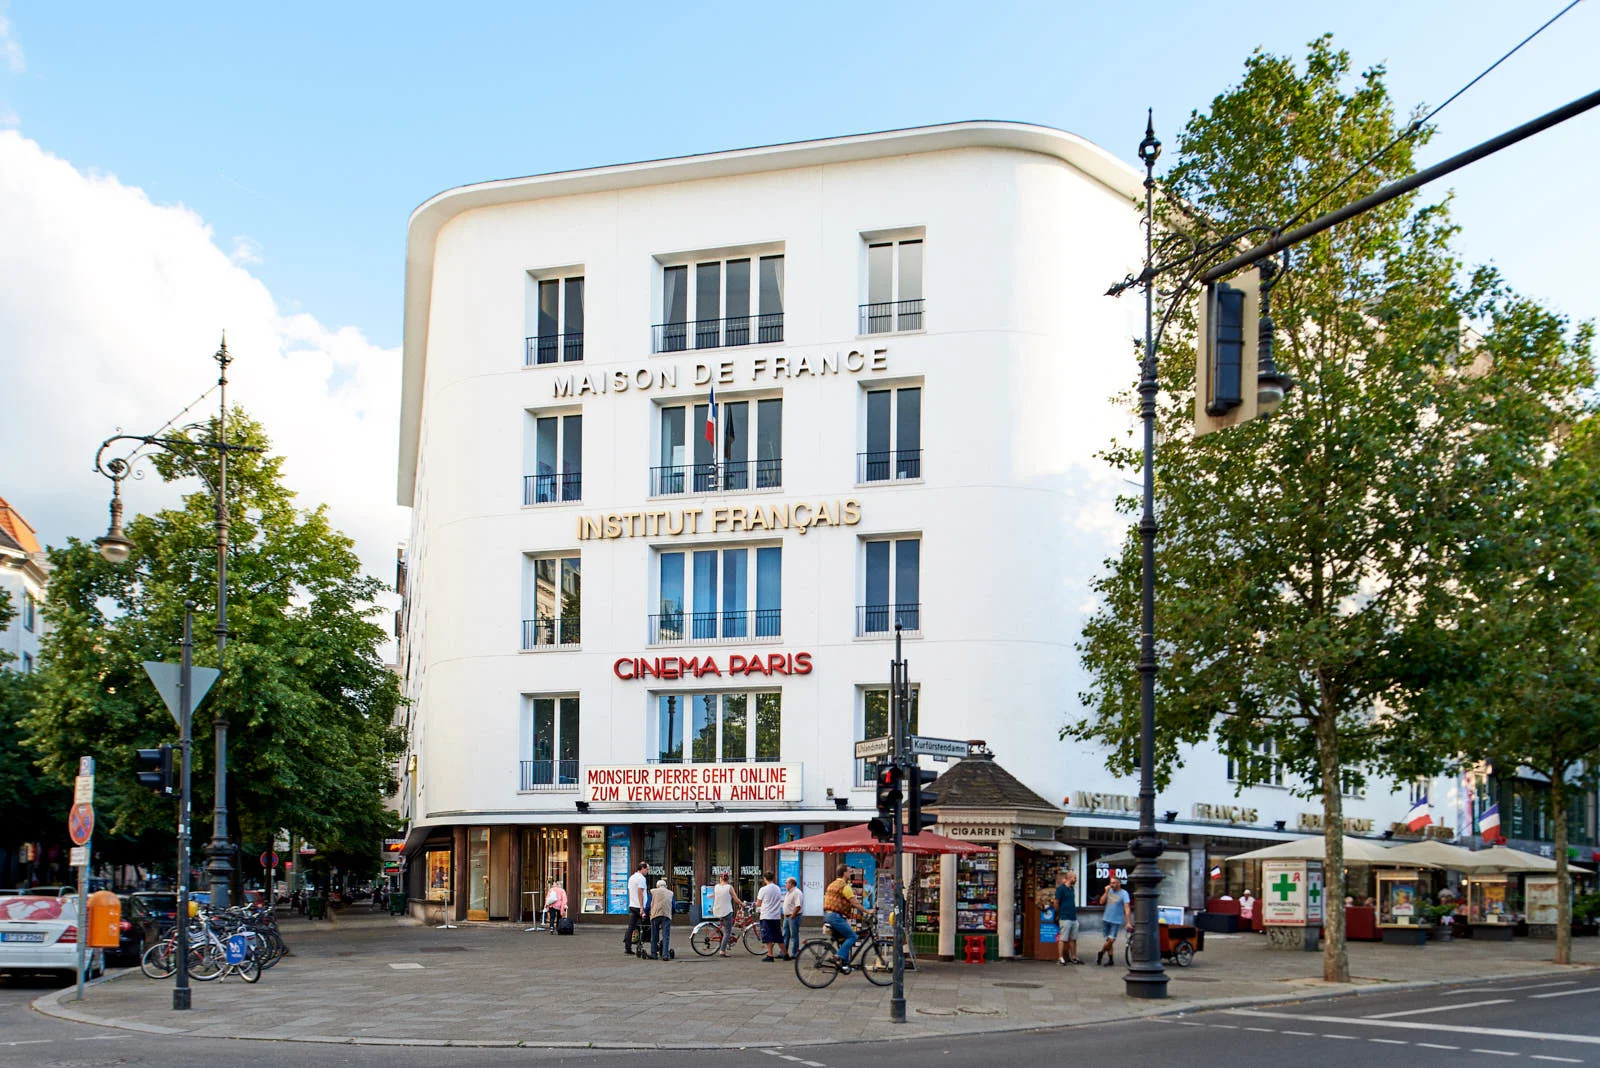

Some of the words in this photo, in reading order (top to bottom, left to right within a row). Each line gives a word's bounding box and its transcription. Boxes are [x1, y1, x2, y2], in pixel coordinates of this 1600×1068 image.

[552, 366, 677, 398] MAISON
[694, 361, 734, 385] DE
[752, 347, 888, 381] FRANCE
[576, 509, 703, 540] INSTITUT
[711, 500, 861, 534] FRANÇAIS
[613, 655, 722, 680] CINEMA
[729, 652, 813, 676] PARIS
[914, 739, 966, 753] Kurfürstendamm
[588, 769, 649, 785] MONSIEUR
[654, 768, 698, 784] PIERRE
[702, 768, 735, 784] GEHT
[740, 767, 787, 783] ONLINE
[591, 786, 619, 801] ZUM
[628, 785, 722, 801] VERWECHSELN
[730, 783, 785, 800] ÄHNLICH
[1193, 802, 1259, 825] FRANÇAIS
[951, 827, 1006, 837] CIGARREN
